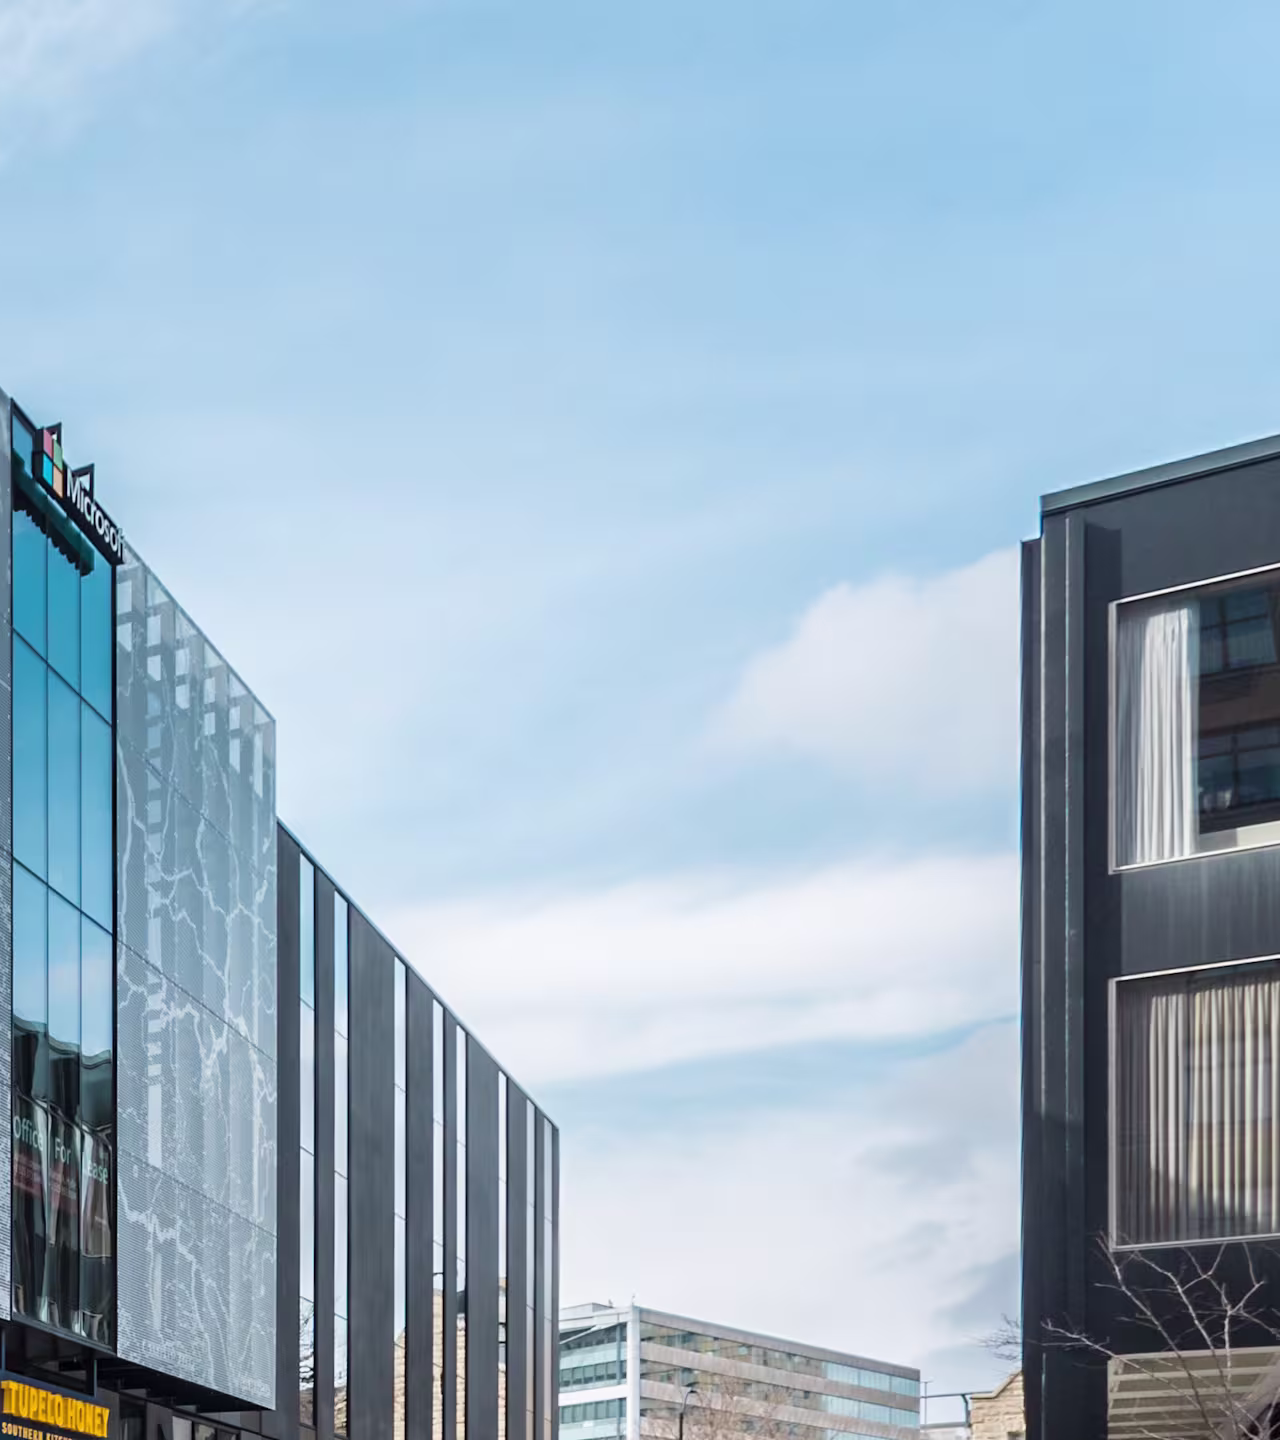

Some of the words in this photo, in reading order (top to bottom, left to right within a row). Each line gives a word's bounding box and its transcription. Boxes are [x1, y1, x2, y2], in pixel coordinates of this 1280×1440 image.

[66, 466, 125, 562] Microsoft
[13, 1115, 44, 1152] Office
[55, 1137, 71, 1165] For
[1, 1380, 64, 1428] TUPELO
[65, 1397, 110, 1438] HONEY
